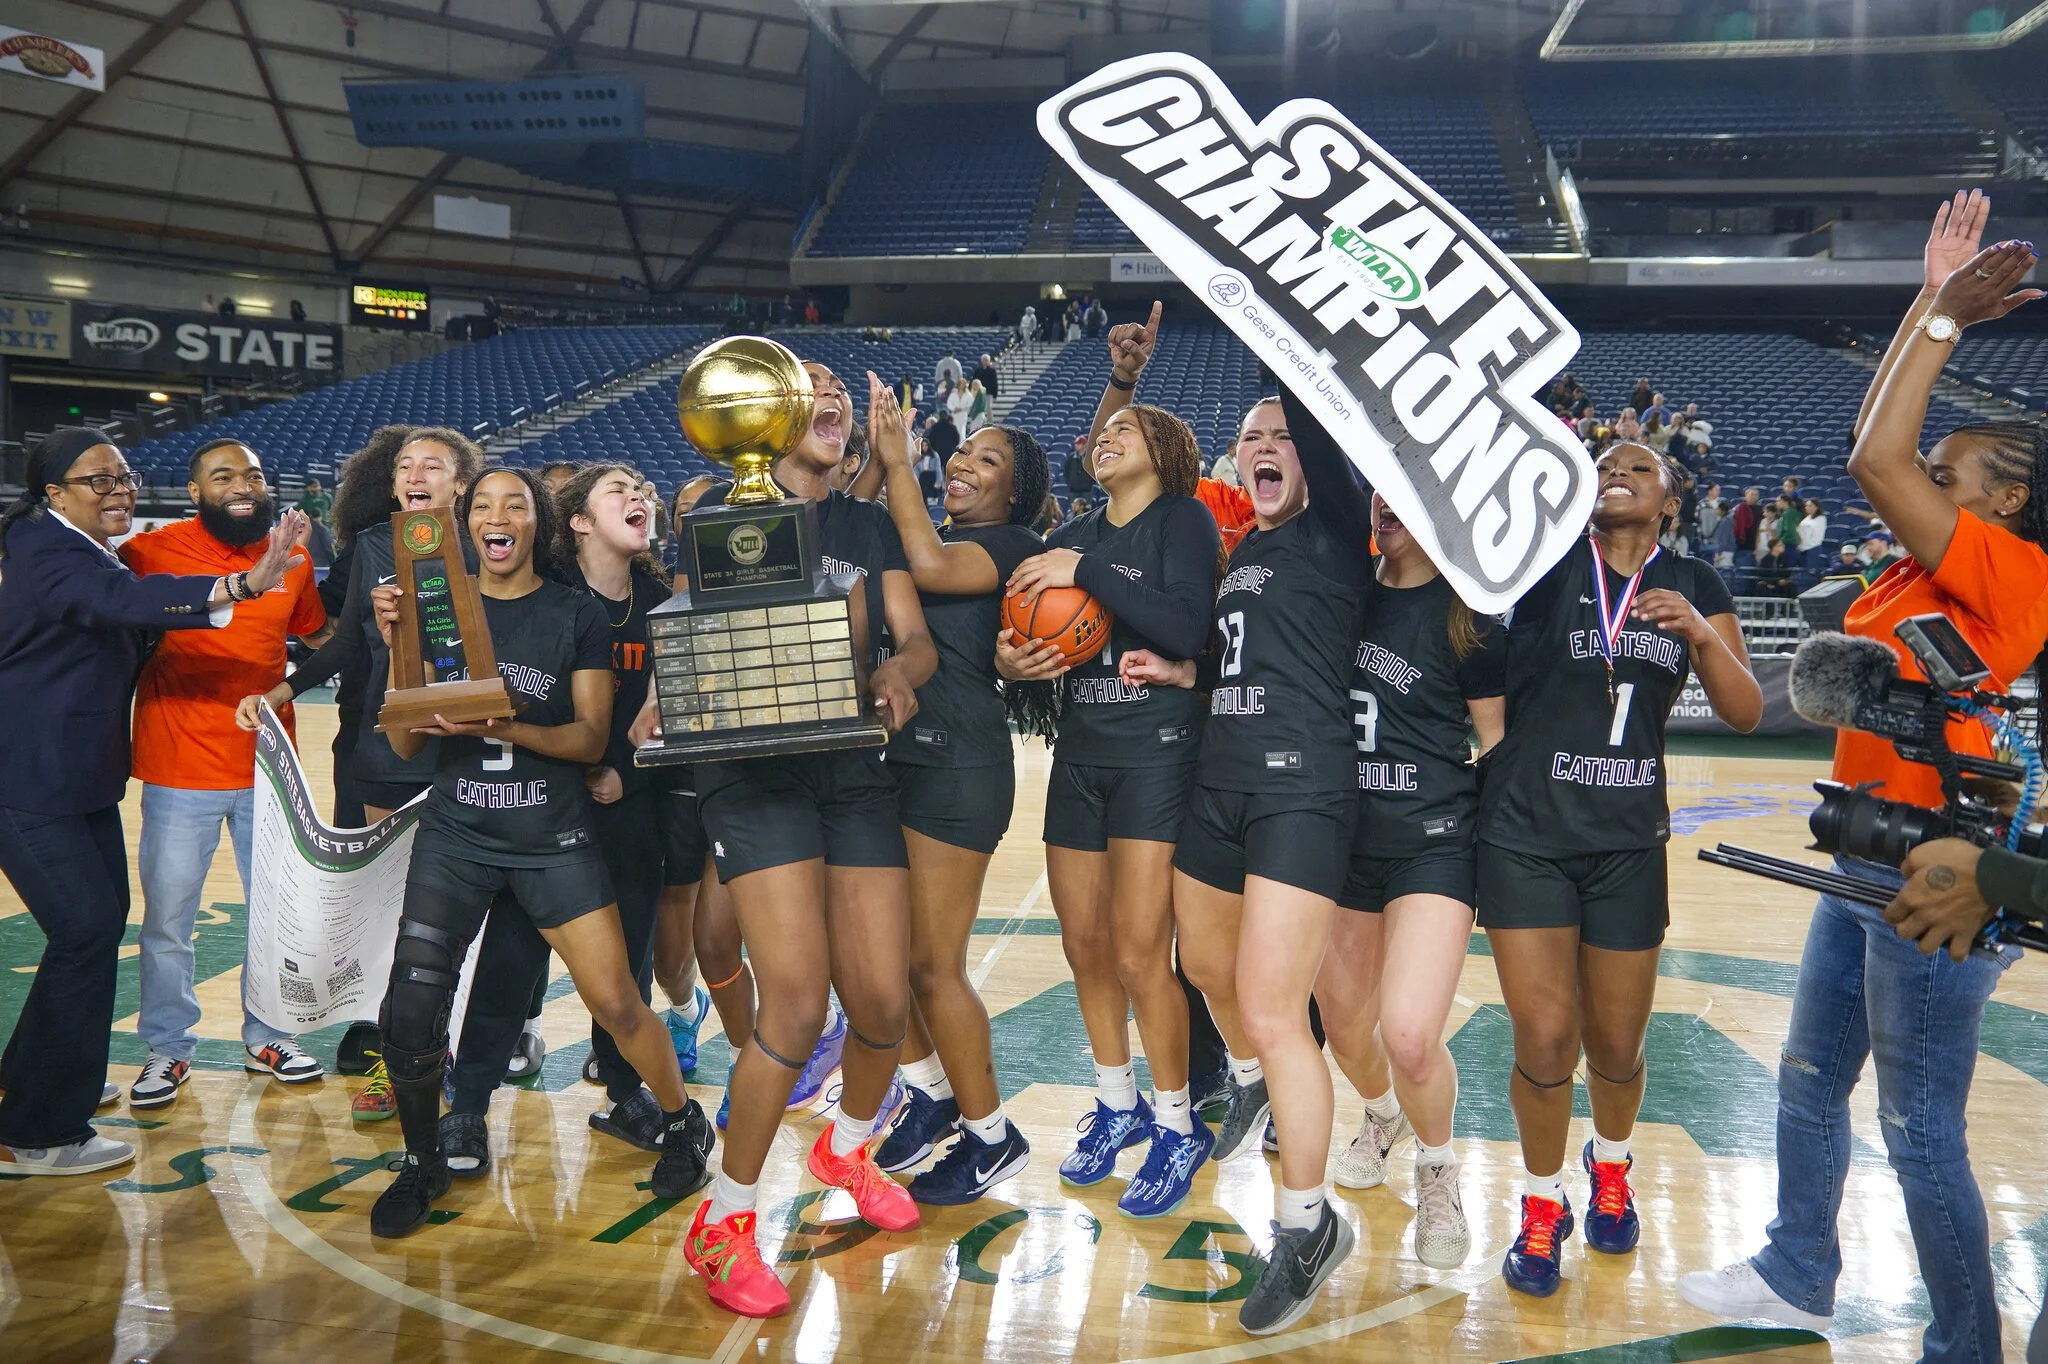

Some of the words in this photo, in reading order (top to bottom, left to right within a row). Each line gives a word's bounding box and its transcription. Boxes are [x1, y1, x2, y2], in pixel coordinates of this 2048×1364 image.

[1250, 124, 1547, 388] STATE
[1342, 234, 1406, 294] WIAA
[1354, 267, 1376, 289] 1905
[26, 309, 54, 326] W
[376, 297, 428, 310] GRAPHICS
[97, 325, 149, 344] WIAA
[1069, 76, 1570, 584] CHAMPIONS
[175, 323, 334, 370] STATE
[1242, 305, 1276, 340] Gesa
[1276, 337, 1317, 382] Credit
[1315, 377, 1351, 421] Union
[703, 571, 722, 580] STATE
[758, 563, 798, 574] BASKETBALL
[735, 573, 768, 582] CHAMPION
[426, 604, 449, 613] 2025-26
[437, 617, 451, 625] Girls
[426, 623, 455, 632] Basketball
[1217, 611, 1245, 679] 13
[1608, 682, 1635, 746] 1
[1357, 762, 1418, 792] HOLIC
[1552, 752, 1657, 788] CATHOLIC
[278, 751, 299, 800] STATE
[297, 798, 401, 855] BASKETBALL
[456, 777, 548, 809] CATHOLIC
